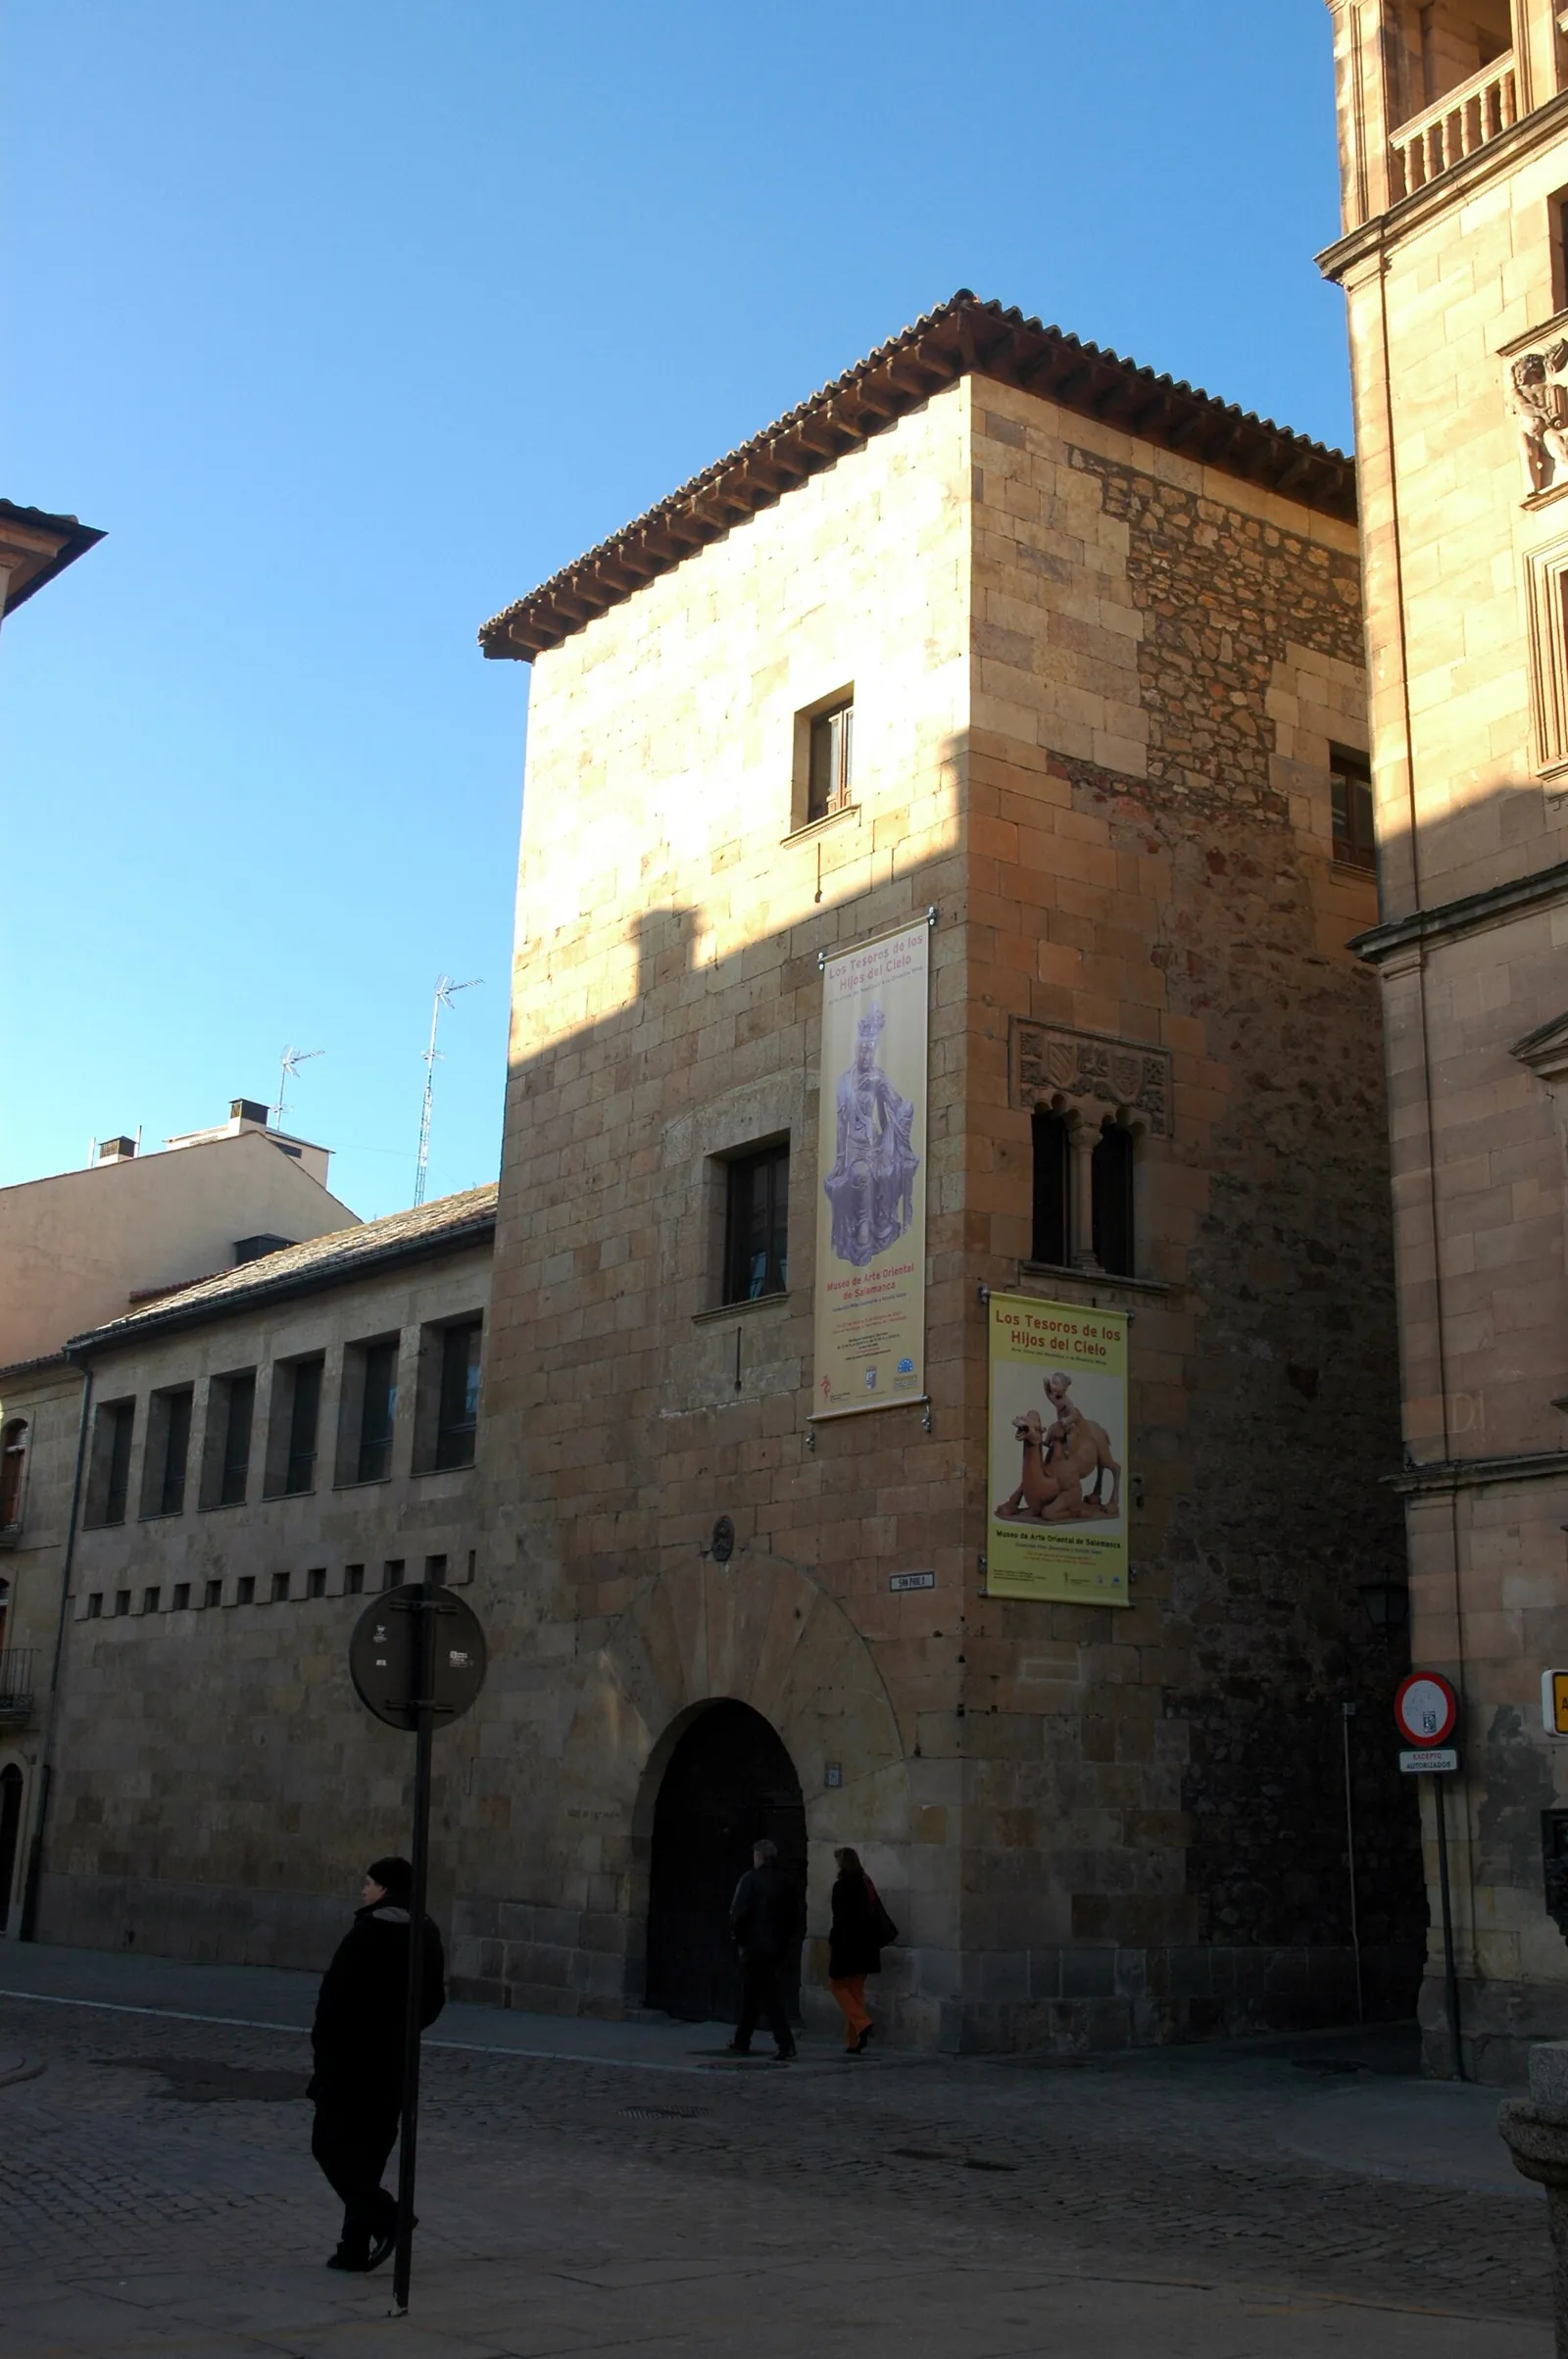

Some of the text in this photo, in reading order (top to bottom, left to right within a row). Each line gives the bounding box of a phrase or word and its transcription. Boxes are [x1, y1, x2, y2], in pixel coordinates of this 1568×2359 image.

[829, 935, 923, 979] Los Tesoros de los
[867, 965, 882, 979] del
[886, 955, 911, 972] Cielo
[826, 1263, 914, 1292] Museo de Arte Oriental
[843, 1282, 896, 1301] de Salamanca
[996, 1309, 1121, 1341] Los Tesoros de los
[1011, 1330, 1045, 1348] Hijos
[1050, 1336, 1069, 1351] del
[1074, 1340, 1106, 1356] Cielo
[996, 1530, 1018, 1539] Museo
[1030, 1533, 1046, 1542] Arte
[1048, 1535, 1074, 1545] Oriental
[1076, 1537, 1084, 1546] de
[1085, 1539, 1121, 1548] Salamanca
